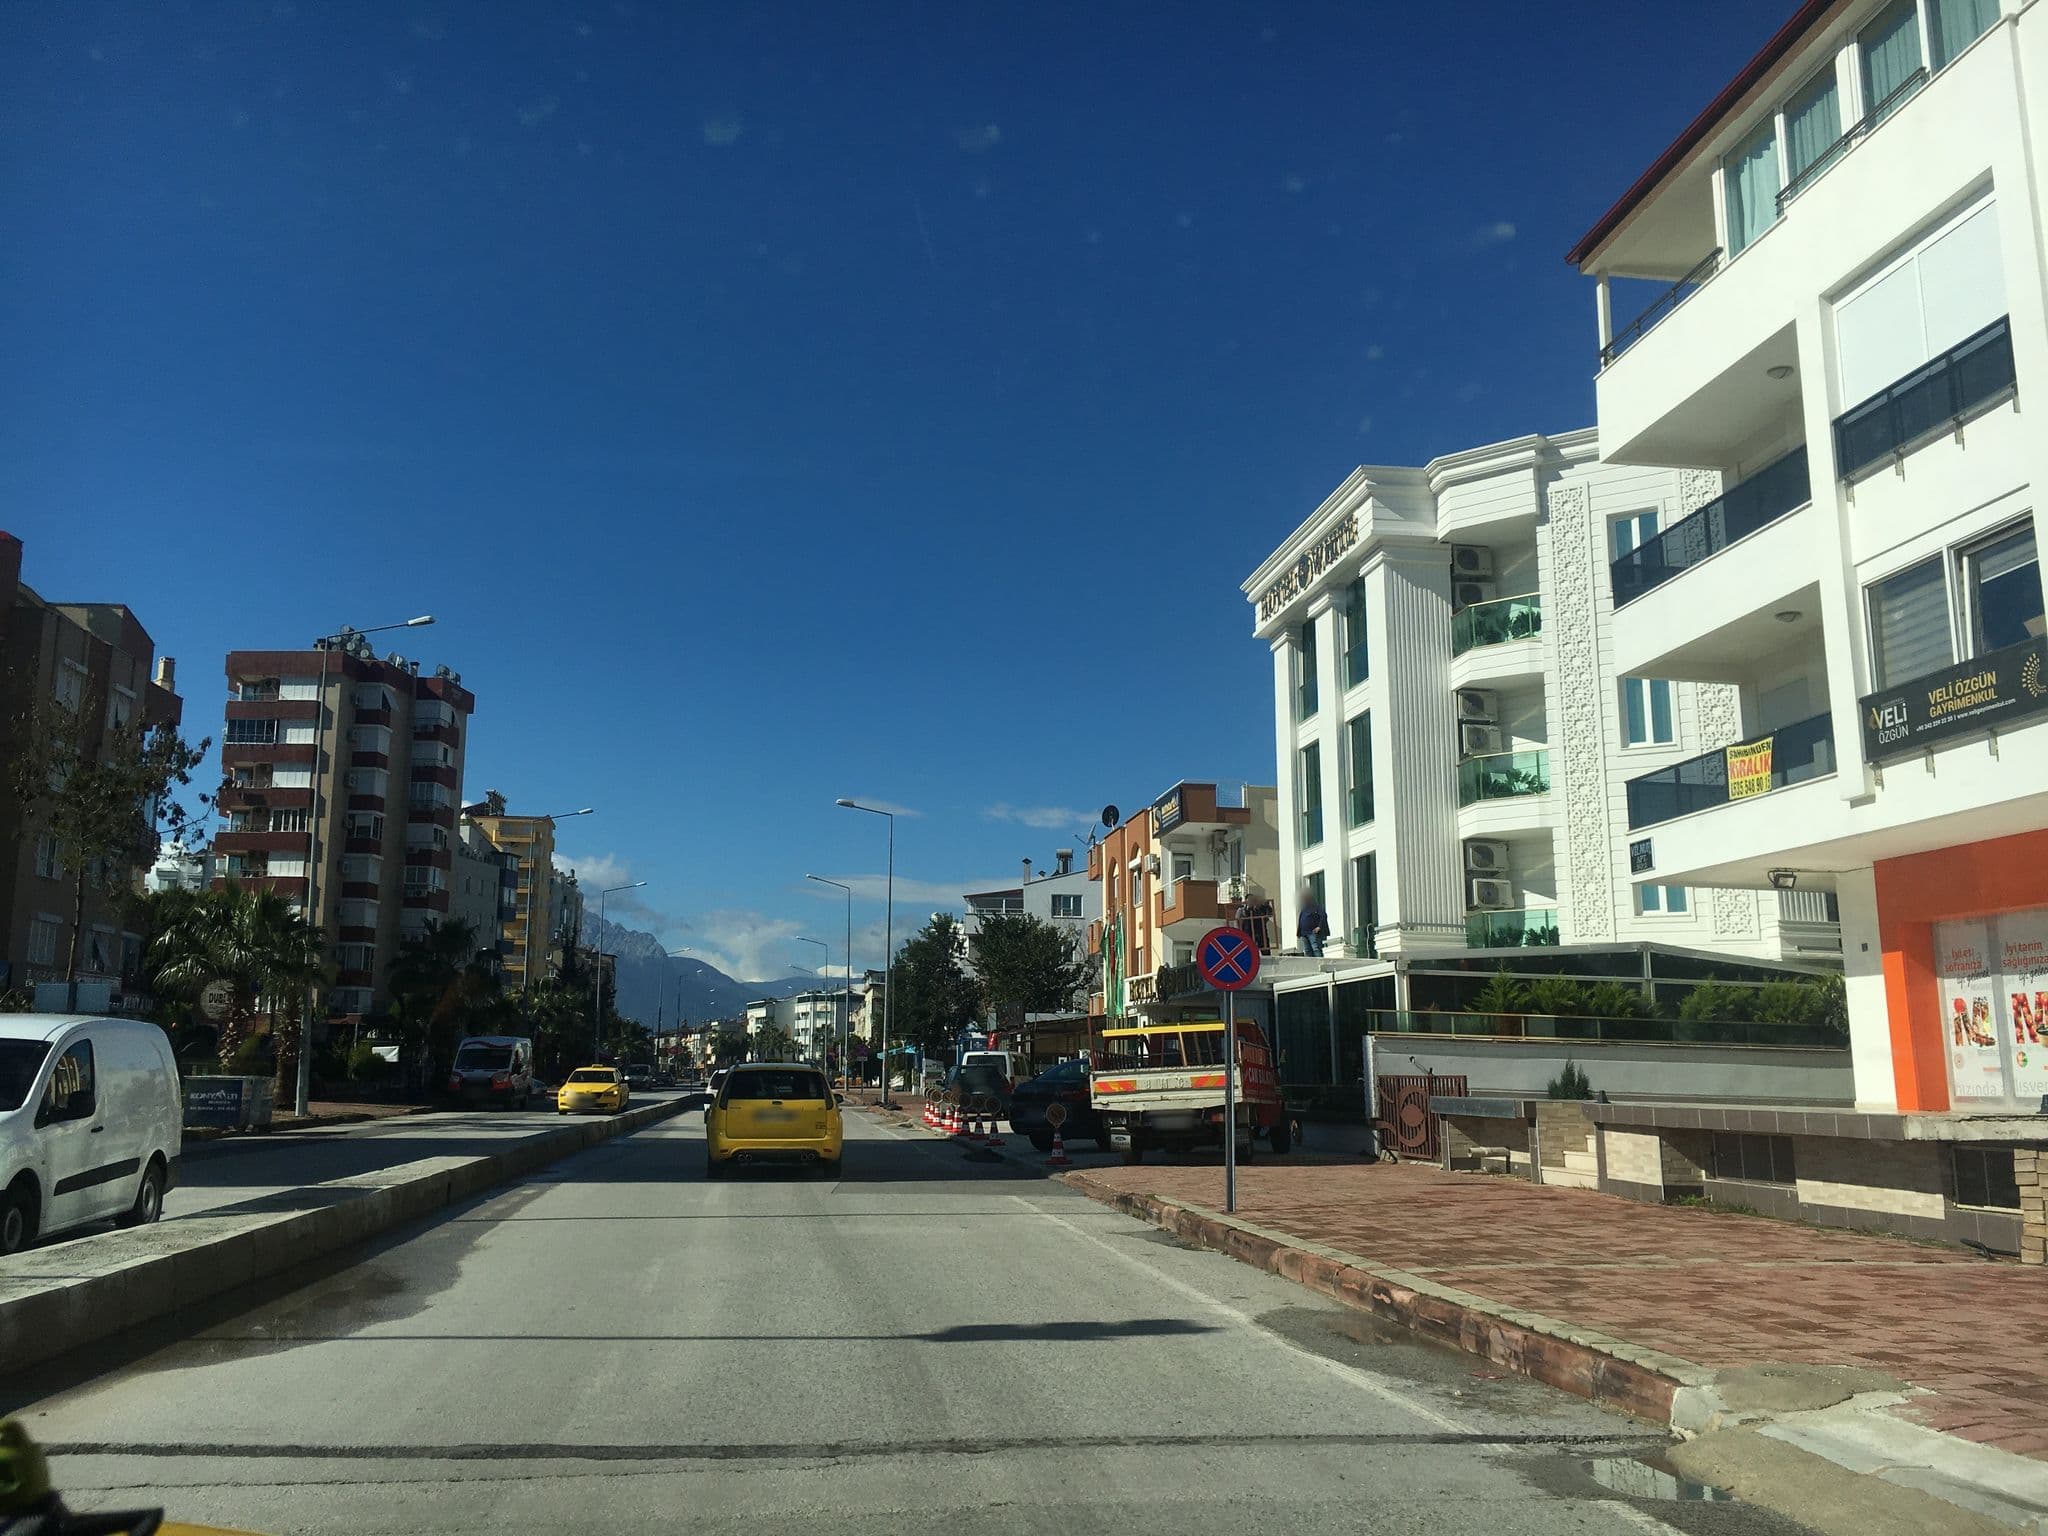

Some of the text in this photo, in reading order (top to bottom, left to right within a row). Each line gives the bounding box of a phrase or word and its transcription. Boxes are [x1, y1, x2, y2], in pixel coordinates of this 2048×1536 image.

[1955, 671, 1996, 696] ÖZGÜN
[1929, 688, 1998, 718] GAYRİMENKUL
[1878, 724, 1909, 744] ÖZGÜN
